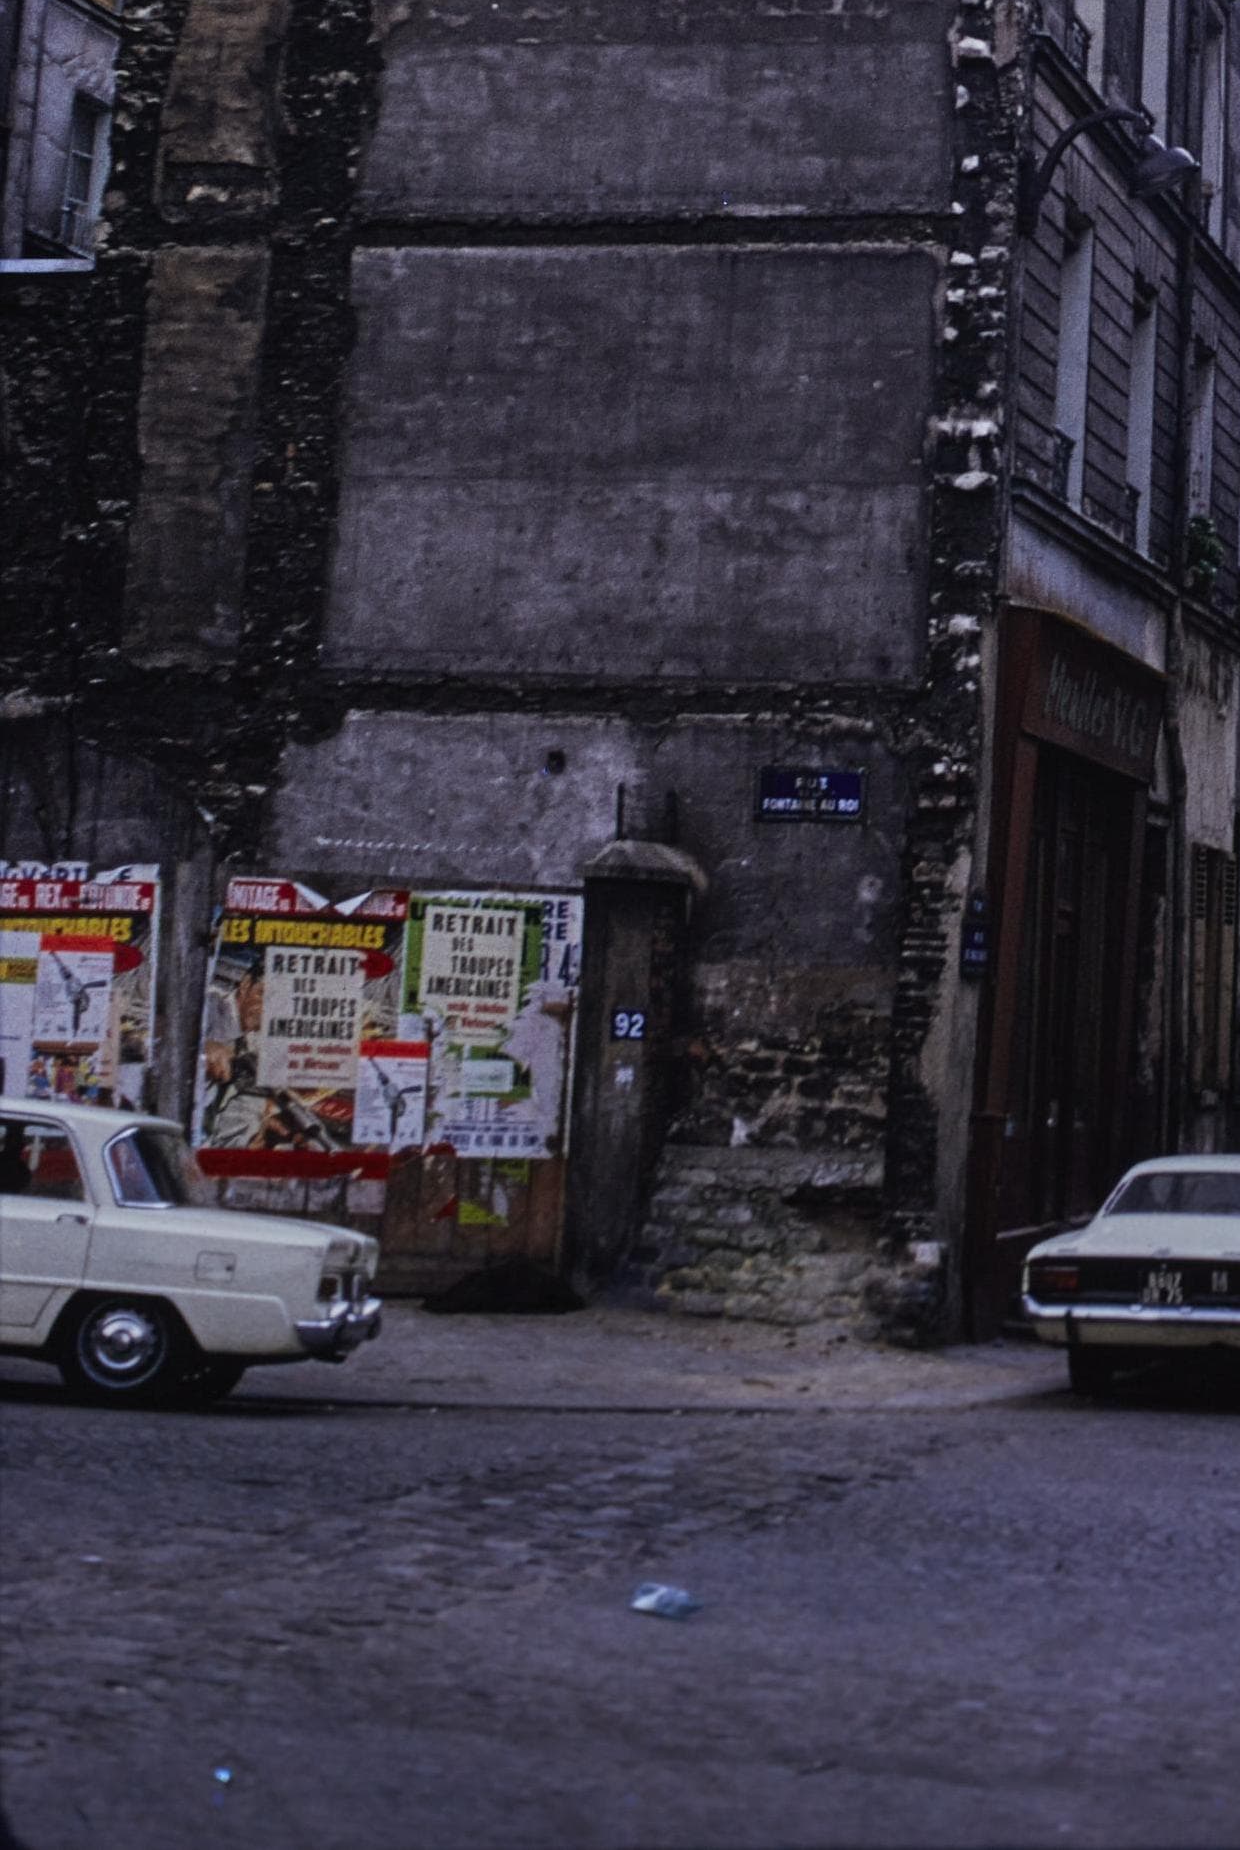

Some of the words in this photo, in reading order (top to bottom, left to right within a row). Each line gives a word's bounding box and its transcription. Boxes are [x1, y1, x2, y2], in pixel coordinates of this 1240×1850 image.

[820, 799, 836, 810] AU
[838, 799, 859, 812] ROI
[222, 919, 250, 943] LES
[254, 920, 387, 948] INTOUCHABLES
[432, 913, 517, 936] RETRAIT
[452, 936, 475, 952] DES
[273, 953, 359, 975] RETRAIT
[451, 955, 514, 978] TROUPES
[293, 978, 316, 993] DES
[426, 976, 511, 999] AMERICAINES
[293, 996, 356, 1018] TROUPES
[268, 1017, 353, 1040] AMERICAINES
[615, 1013, 645, 1037] 92
